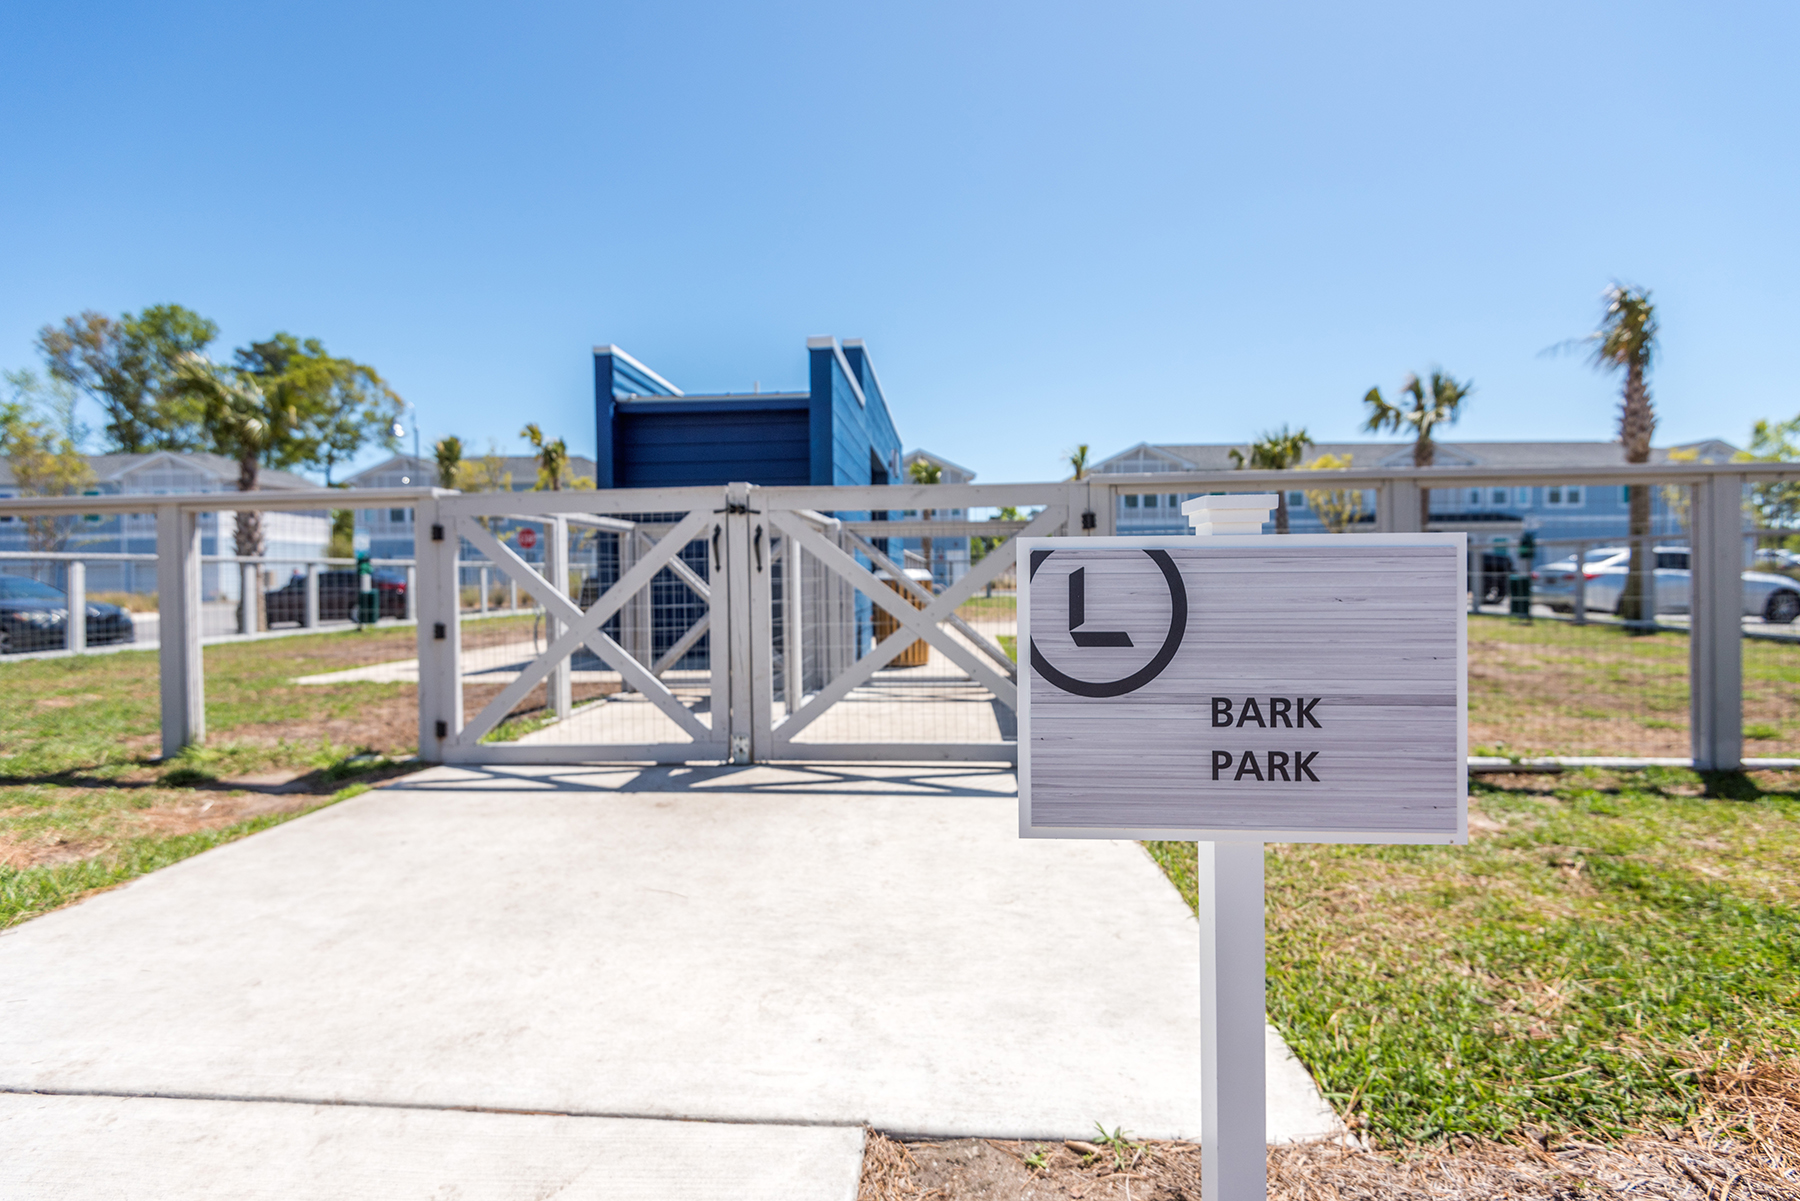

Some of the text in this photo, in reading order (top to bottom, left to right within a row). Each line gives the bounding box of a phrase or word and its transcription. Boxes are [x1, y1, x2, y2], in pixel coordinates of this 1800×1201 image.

[1069, 566, 1135, 648] L
[1211, 697, 1323, 729] BARK
[1211, 750, 1321, 782] PARK
